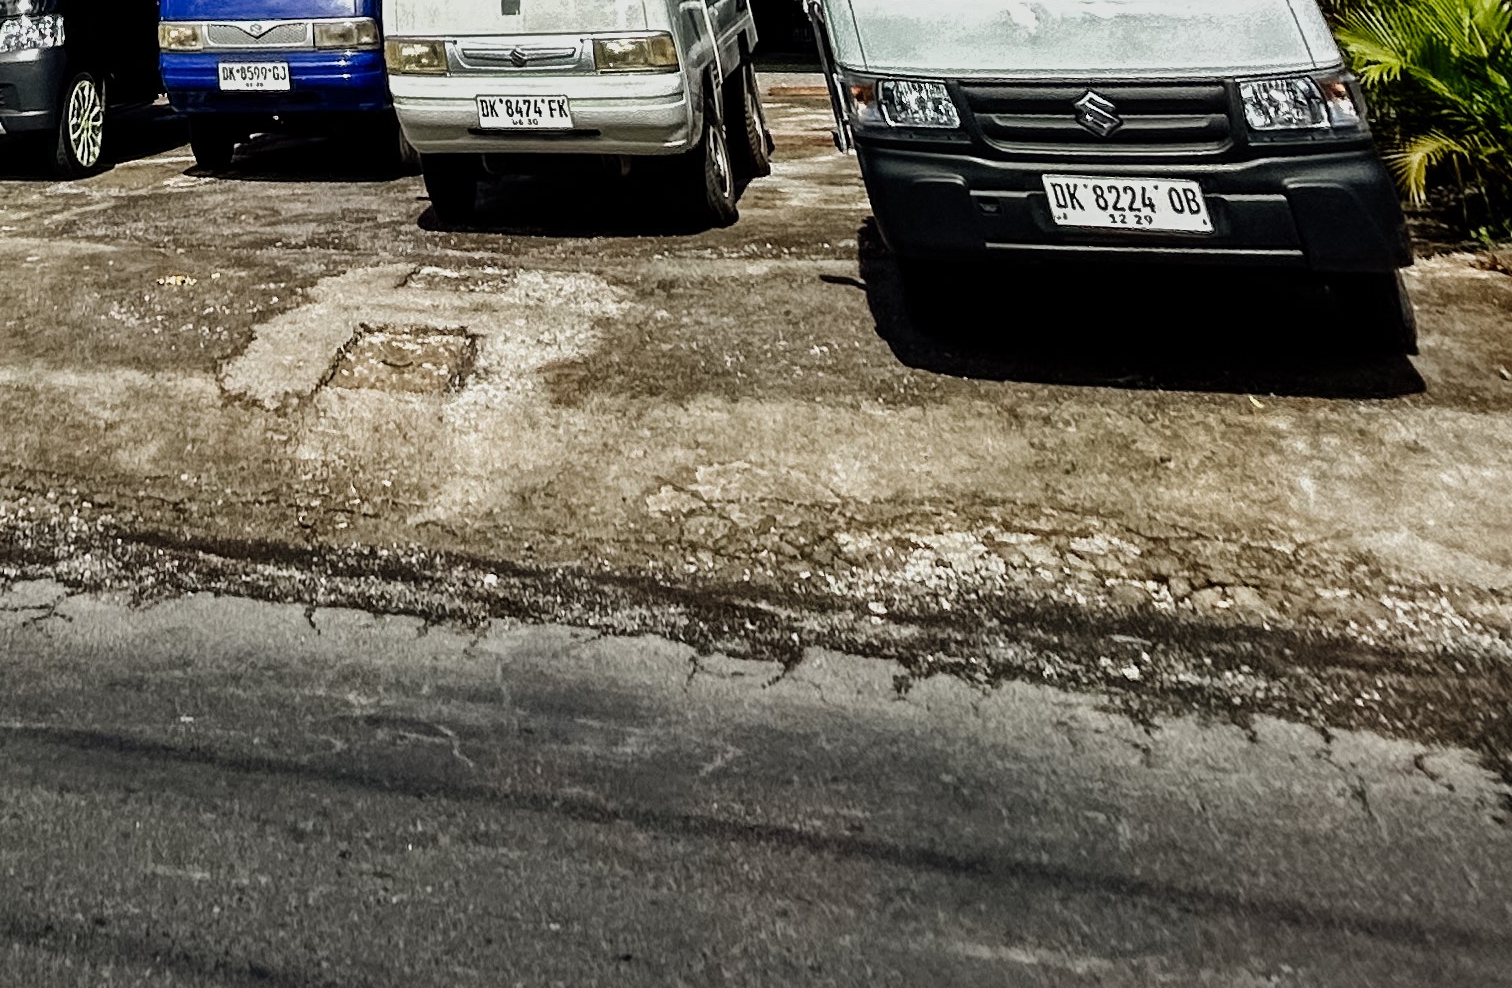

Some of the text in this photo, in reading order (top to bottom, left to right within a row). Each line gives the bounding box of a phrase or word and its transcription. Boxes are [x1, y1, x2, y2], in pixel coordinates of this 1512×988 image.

[222, 66, 236, 81] DK
[272, 66, 286, 81] GJ
[480, 99, 568, 118] DK 8474 FK
[1050, 182, 1085, 211] DK
[1092, 184, 1157, 213] 8224
[1108, 214, 1128, 224] 12
